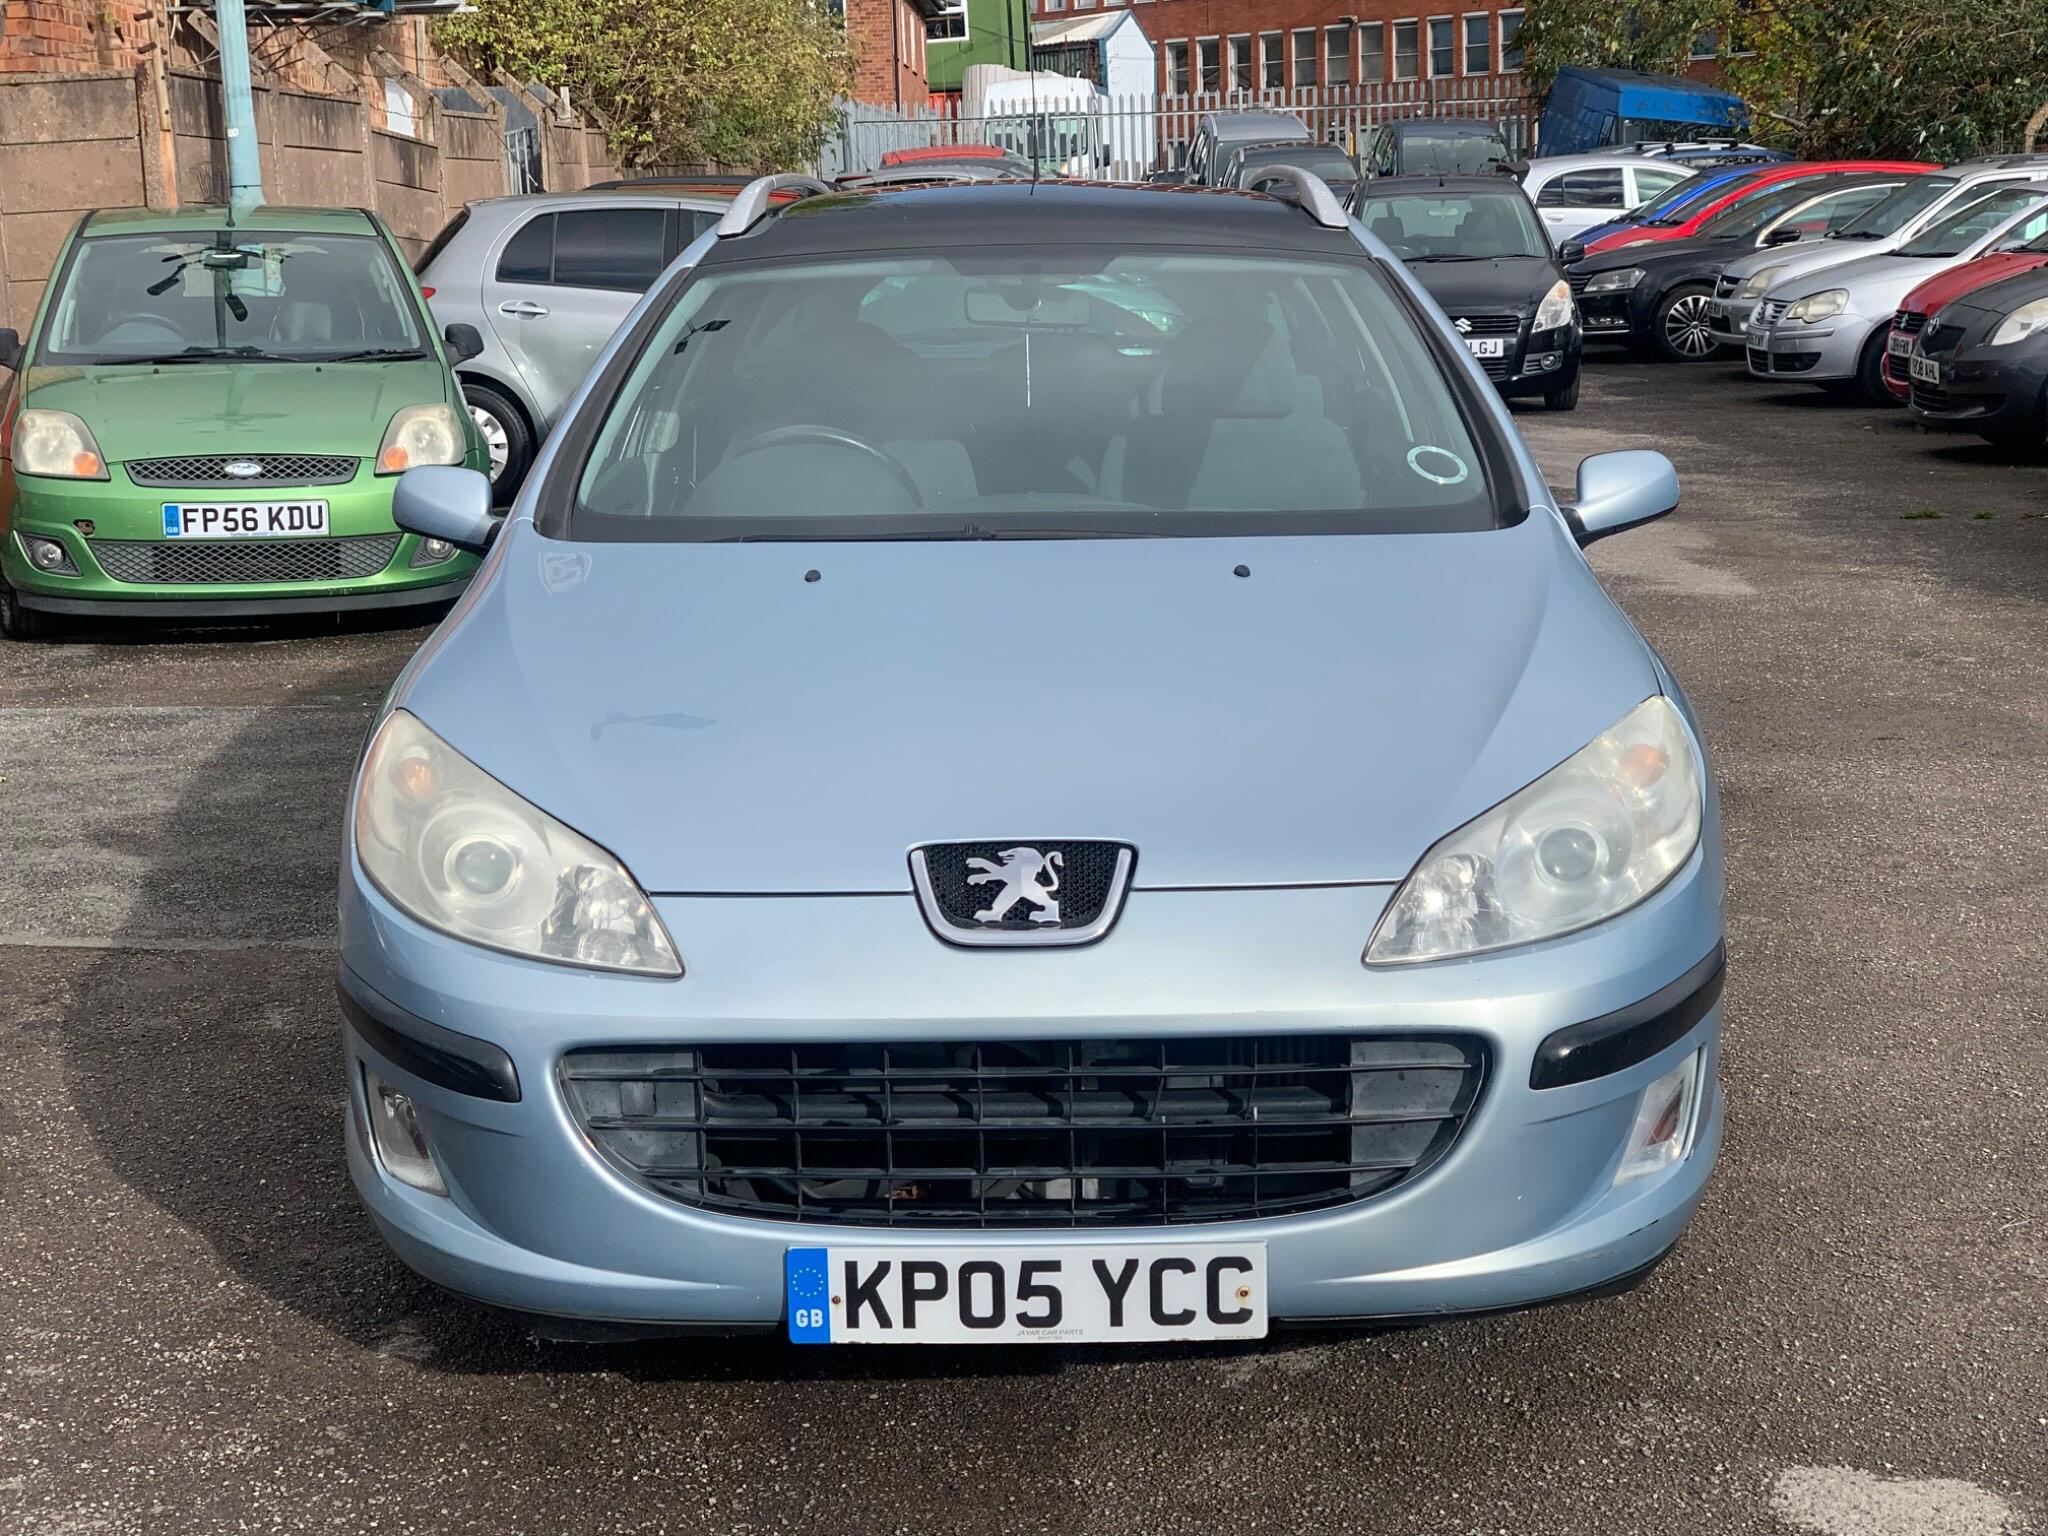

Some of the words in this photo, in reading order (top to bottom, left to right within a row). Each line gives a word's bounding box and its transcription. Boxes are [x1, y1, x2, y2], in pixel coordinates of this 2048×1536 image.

[1470, 341, 1498, 355] LGJ
[182, 507, 258, 533] FP56
[268, 505, 323, 531] KDU
[843, 1259, 1063, 1329] KP05
[1092, 1255, 1254, 1327] YCC
[795, 1308, 824, 1327] GB
